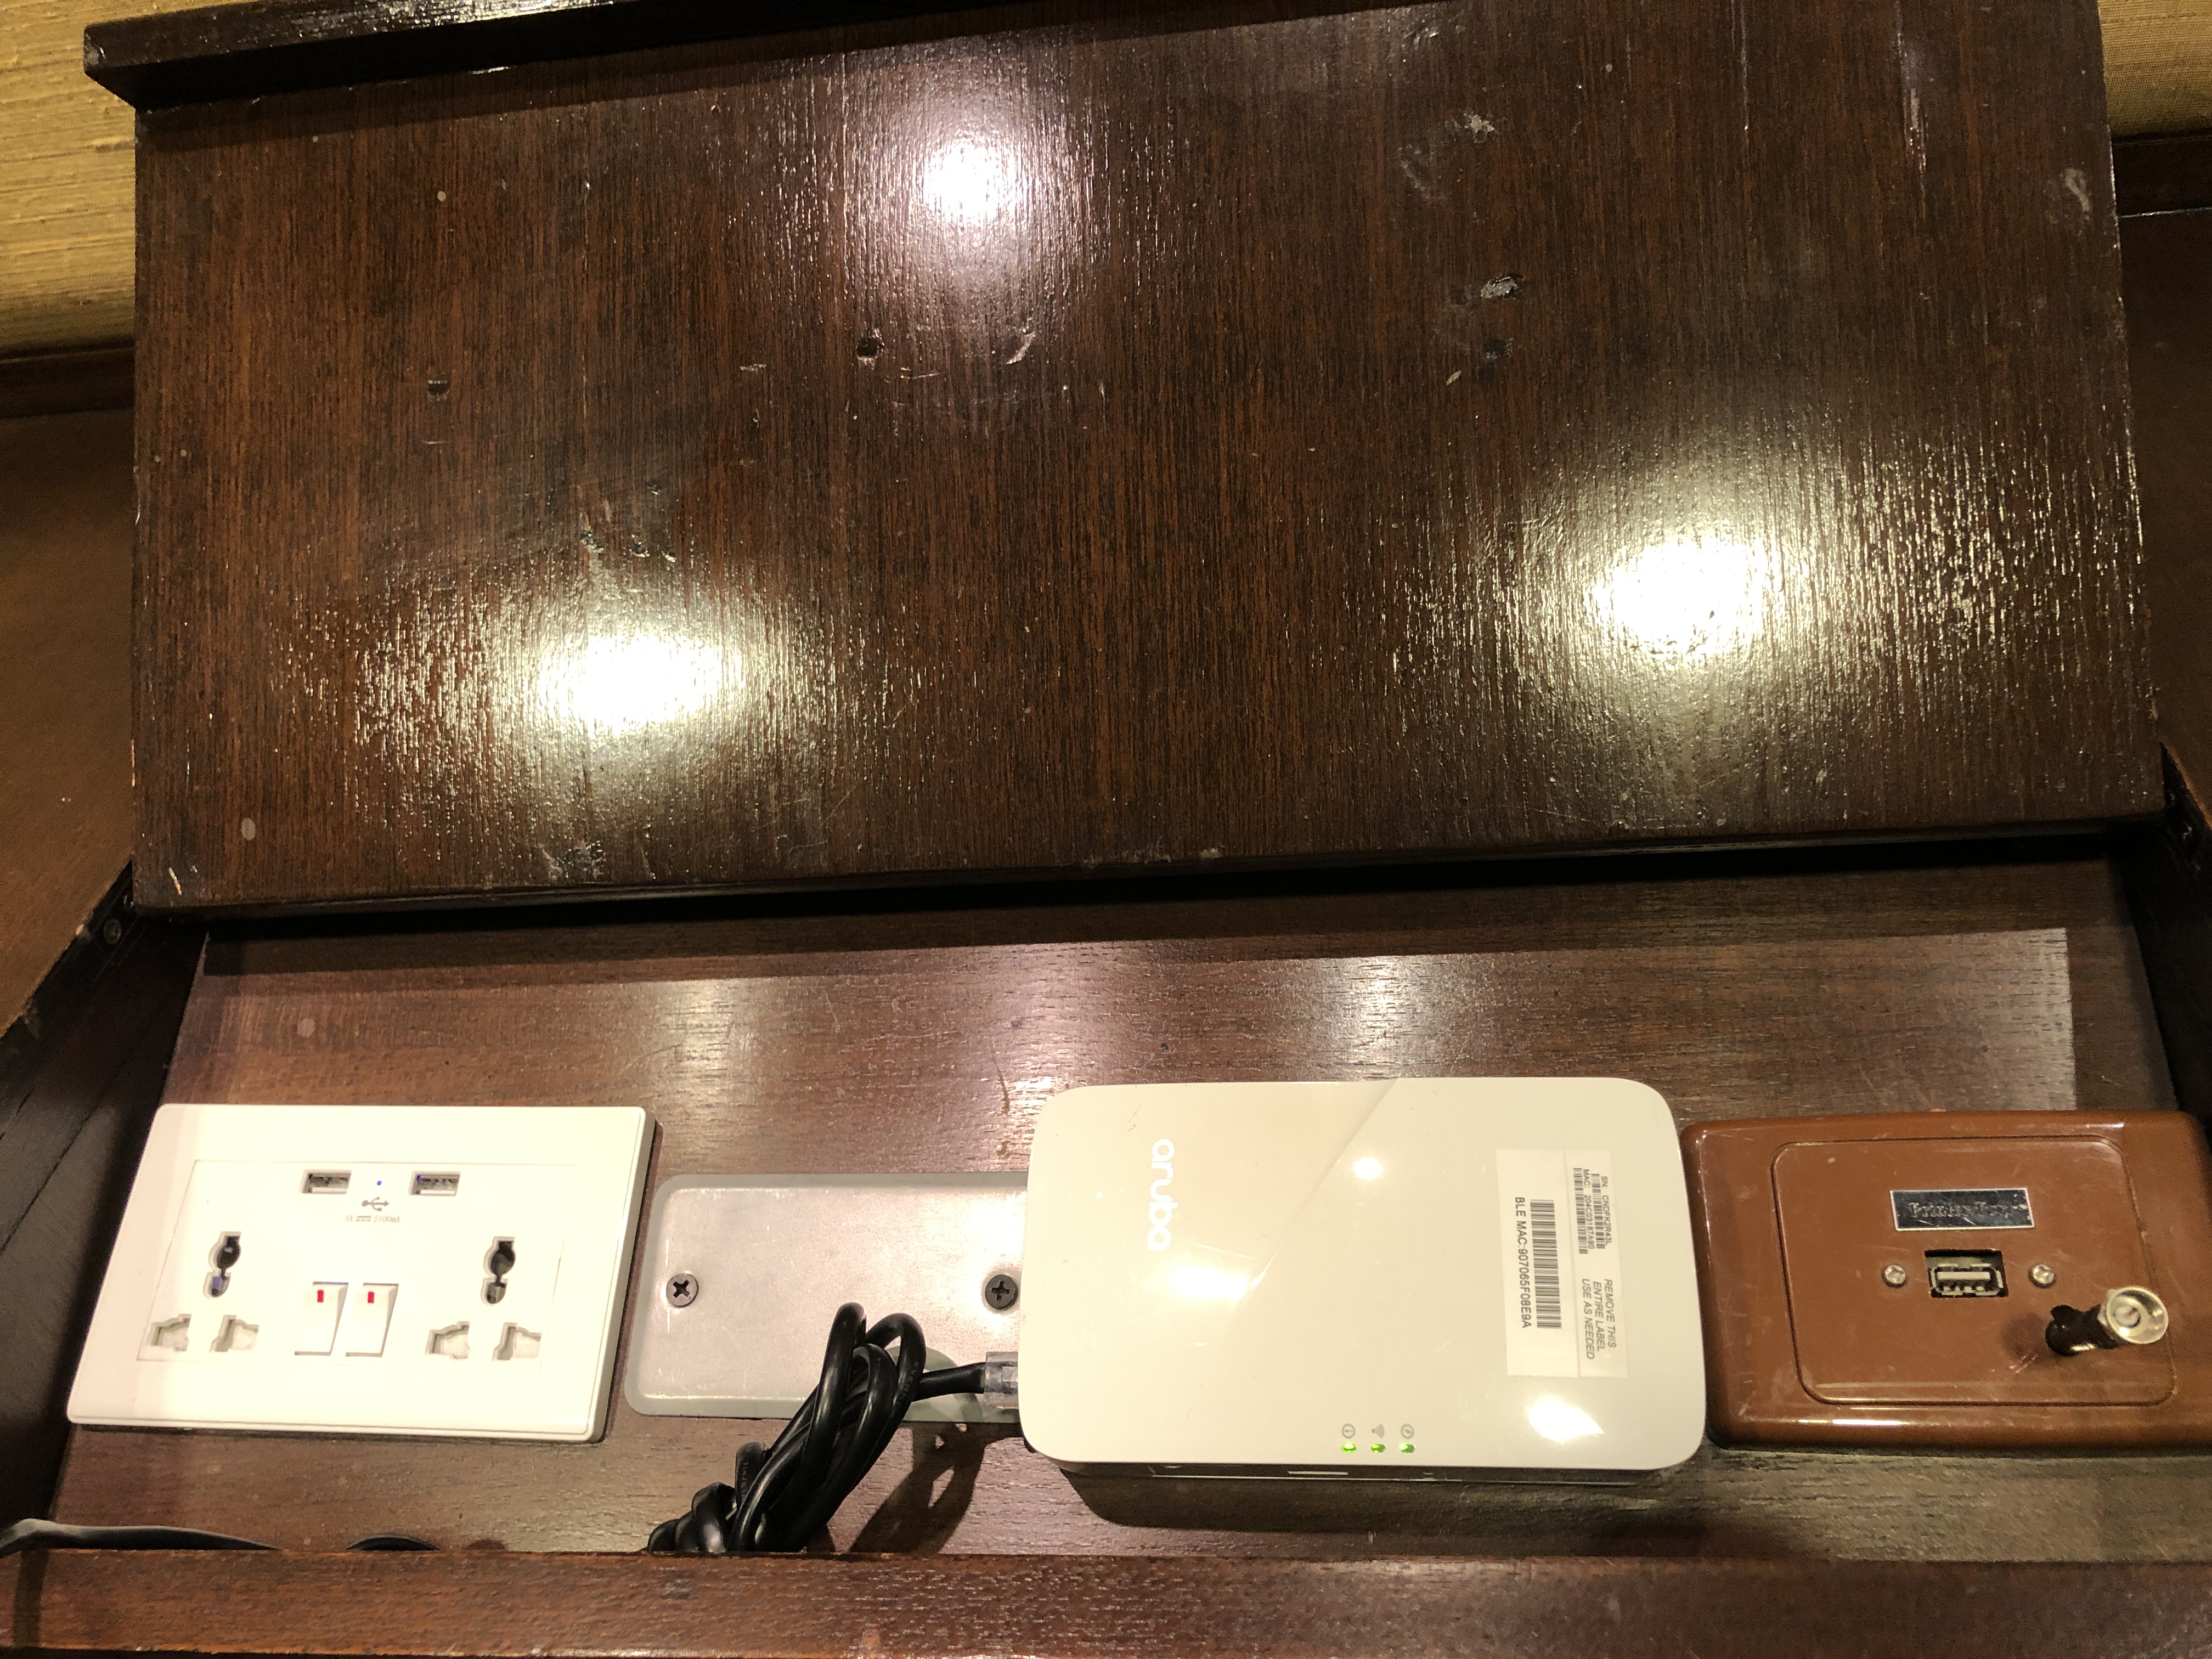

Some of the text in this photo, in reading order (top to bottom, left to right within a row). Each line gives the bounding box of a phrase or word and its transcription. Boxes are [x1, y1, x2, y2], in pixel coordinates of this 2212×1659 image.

[1147, 1139, 1179, 1251] aruba
[1515, 1197, 1532, 1328] BLE MAC:907065F08E9A
[1582, 1278, 1595, 1359] USE AS NEEDED
[1593, 1281, 1605, 1352] ENTIRE LABEL
[1604, 1278, 1617, 1348] REMOVE THIS
